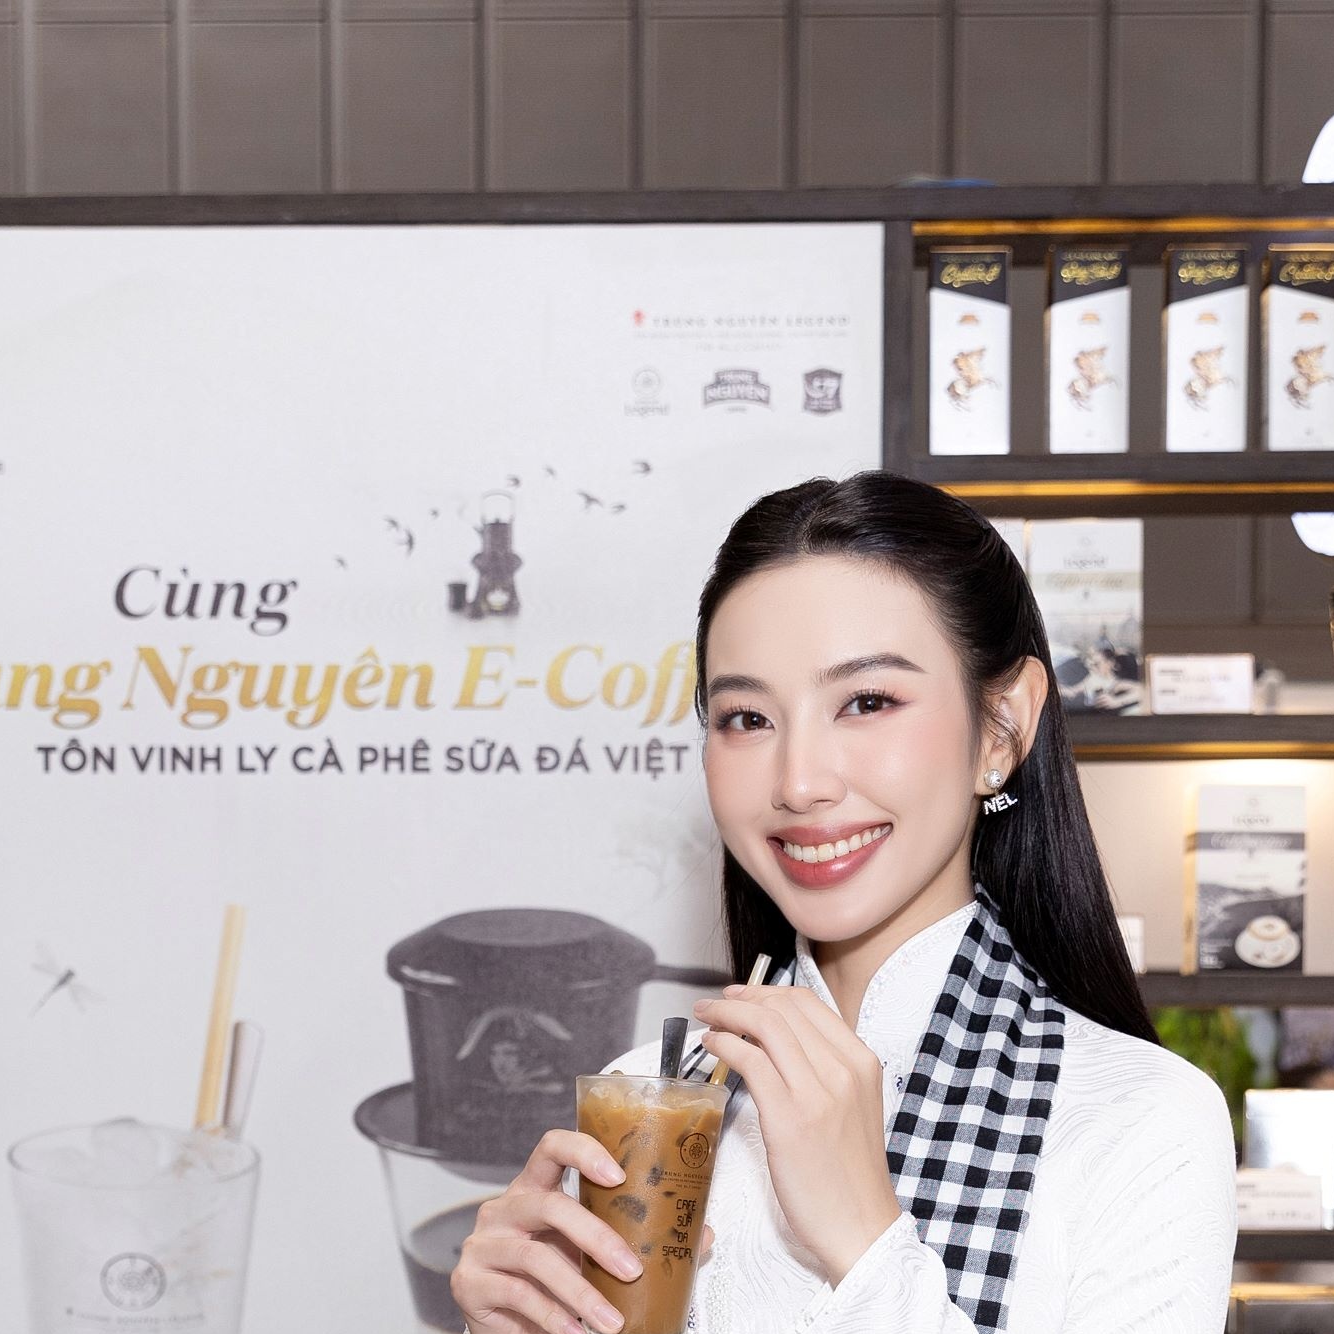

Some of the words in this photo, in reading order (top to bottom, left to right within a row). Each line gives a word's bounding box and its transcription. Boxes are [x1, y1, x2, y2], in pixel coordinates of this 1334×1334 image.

[114, 565, 298, 637] Cùng
[121, 645, 436, 731] Nguyên
[452, 641, 696, 729] E-Coff
[36, 738, 116, 774] TÔN
[131, 746, 222, 774] VINH
[237, 746, 278, 774] LY
[292, 738, 343, 774] CÀ
[359, 738, 431, 773] PHÊ
[445, 739, 520, 774] SỮA
[535, 738, 589, 773] ĐÁ
[605, 738, 689, 780] VIỆT
[983, 791, 1018, 815] NEL
